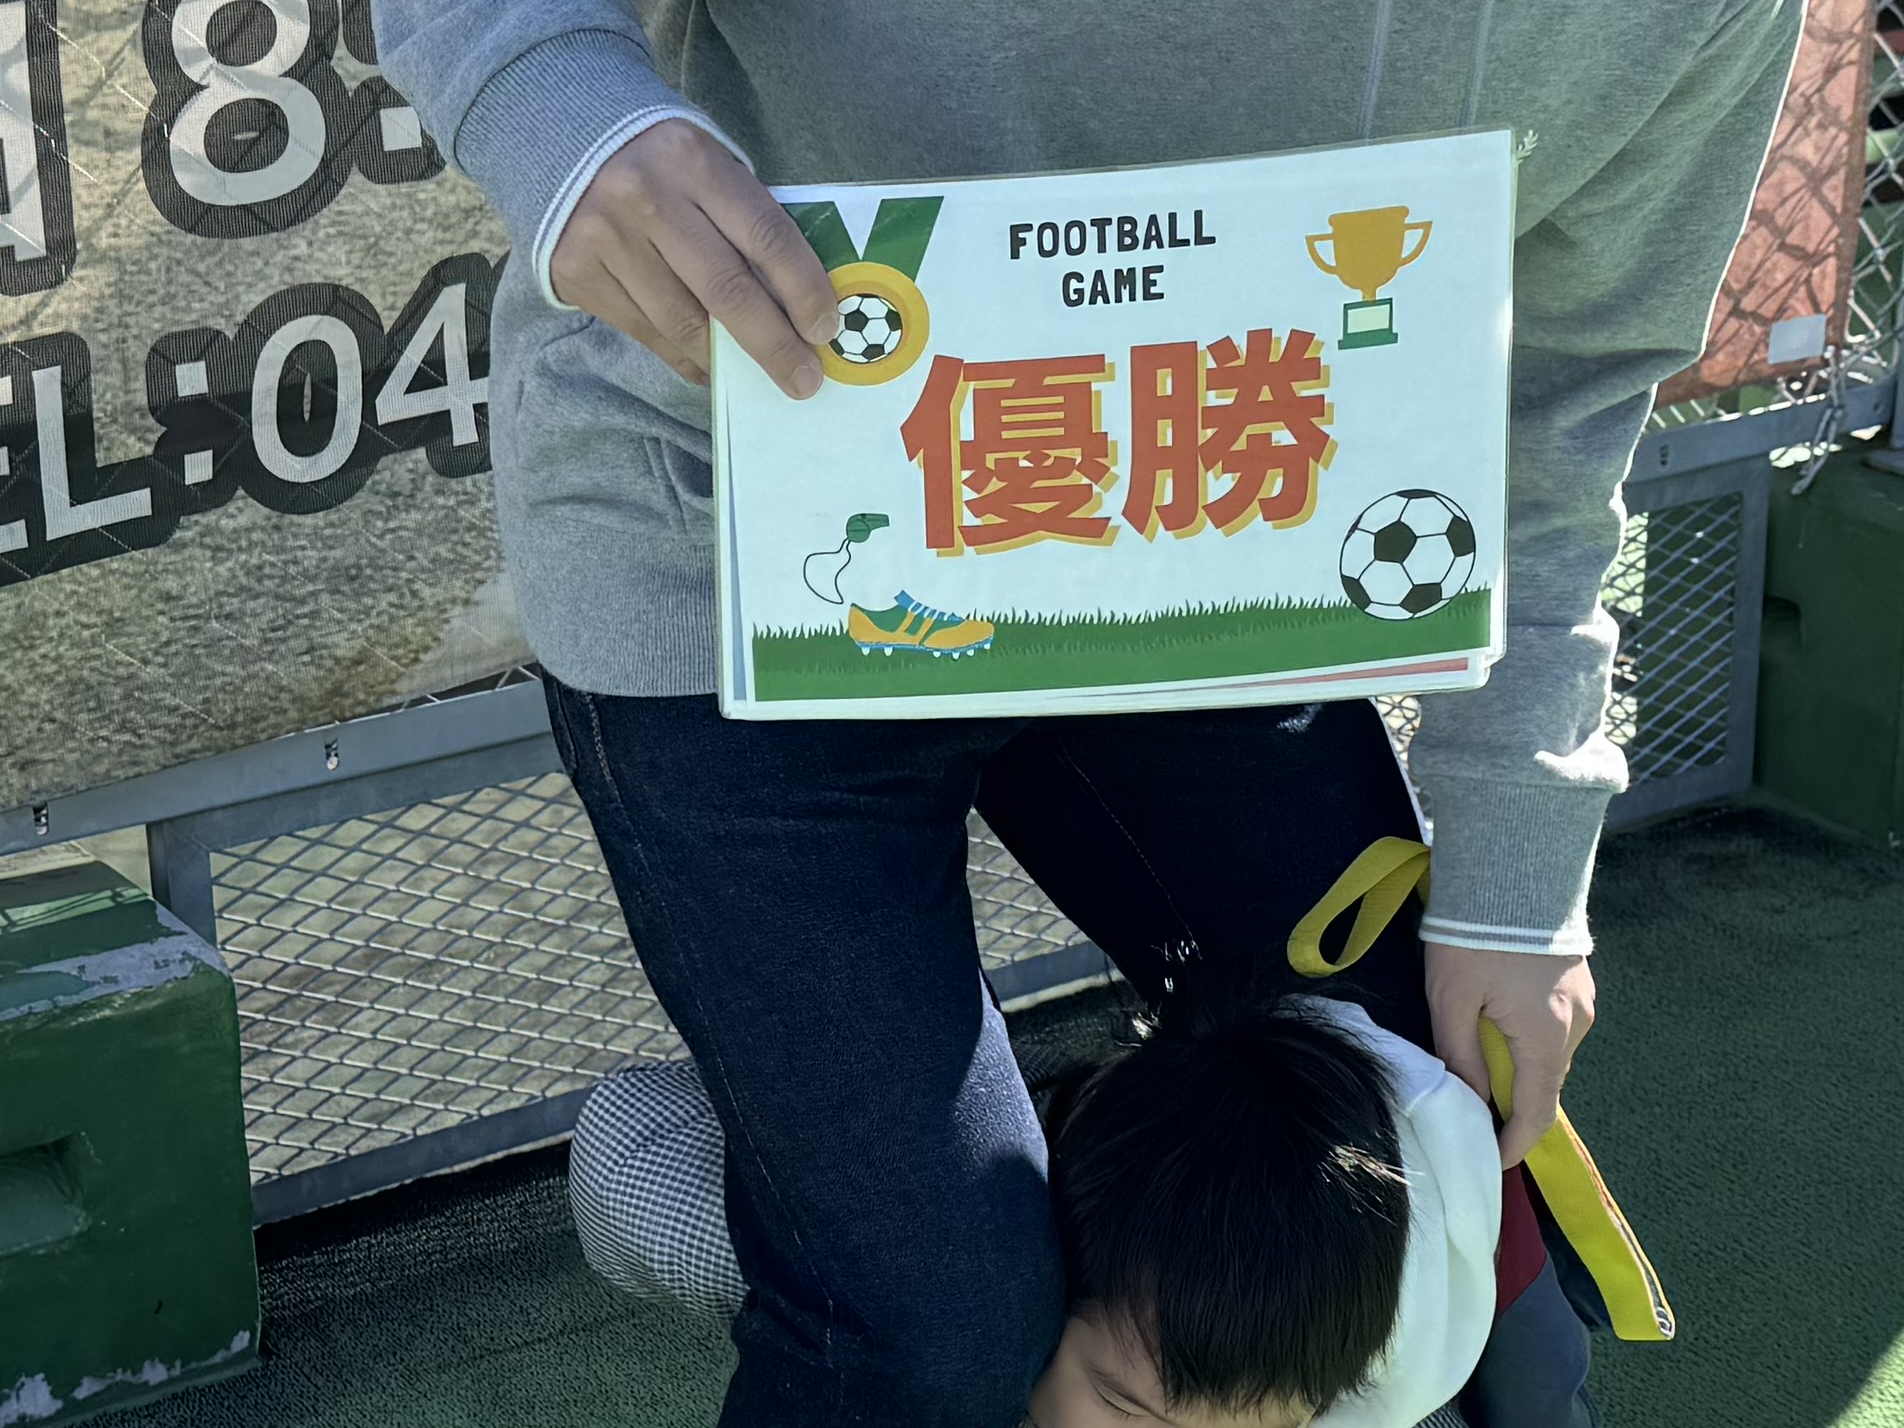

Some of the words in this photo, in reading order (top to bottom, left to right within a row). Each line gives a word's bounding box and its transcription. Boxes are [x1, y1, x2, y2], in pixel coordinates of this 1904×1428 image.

[1007, 208, 1217, 261] FOOTBALL
[1060, 264, 1166, 309] GAME
[899, 327, 1340, 558] 優勝
